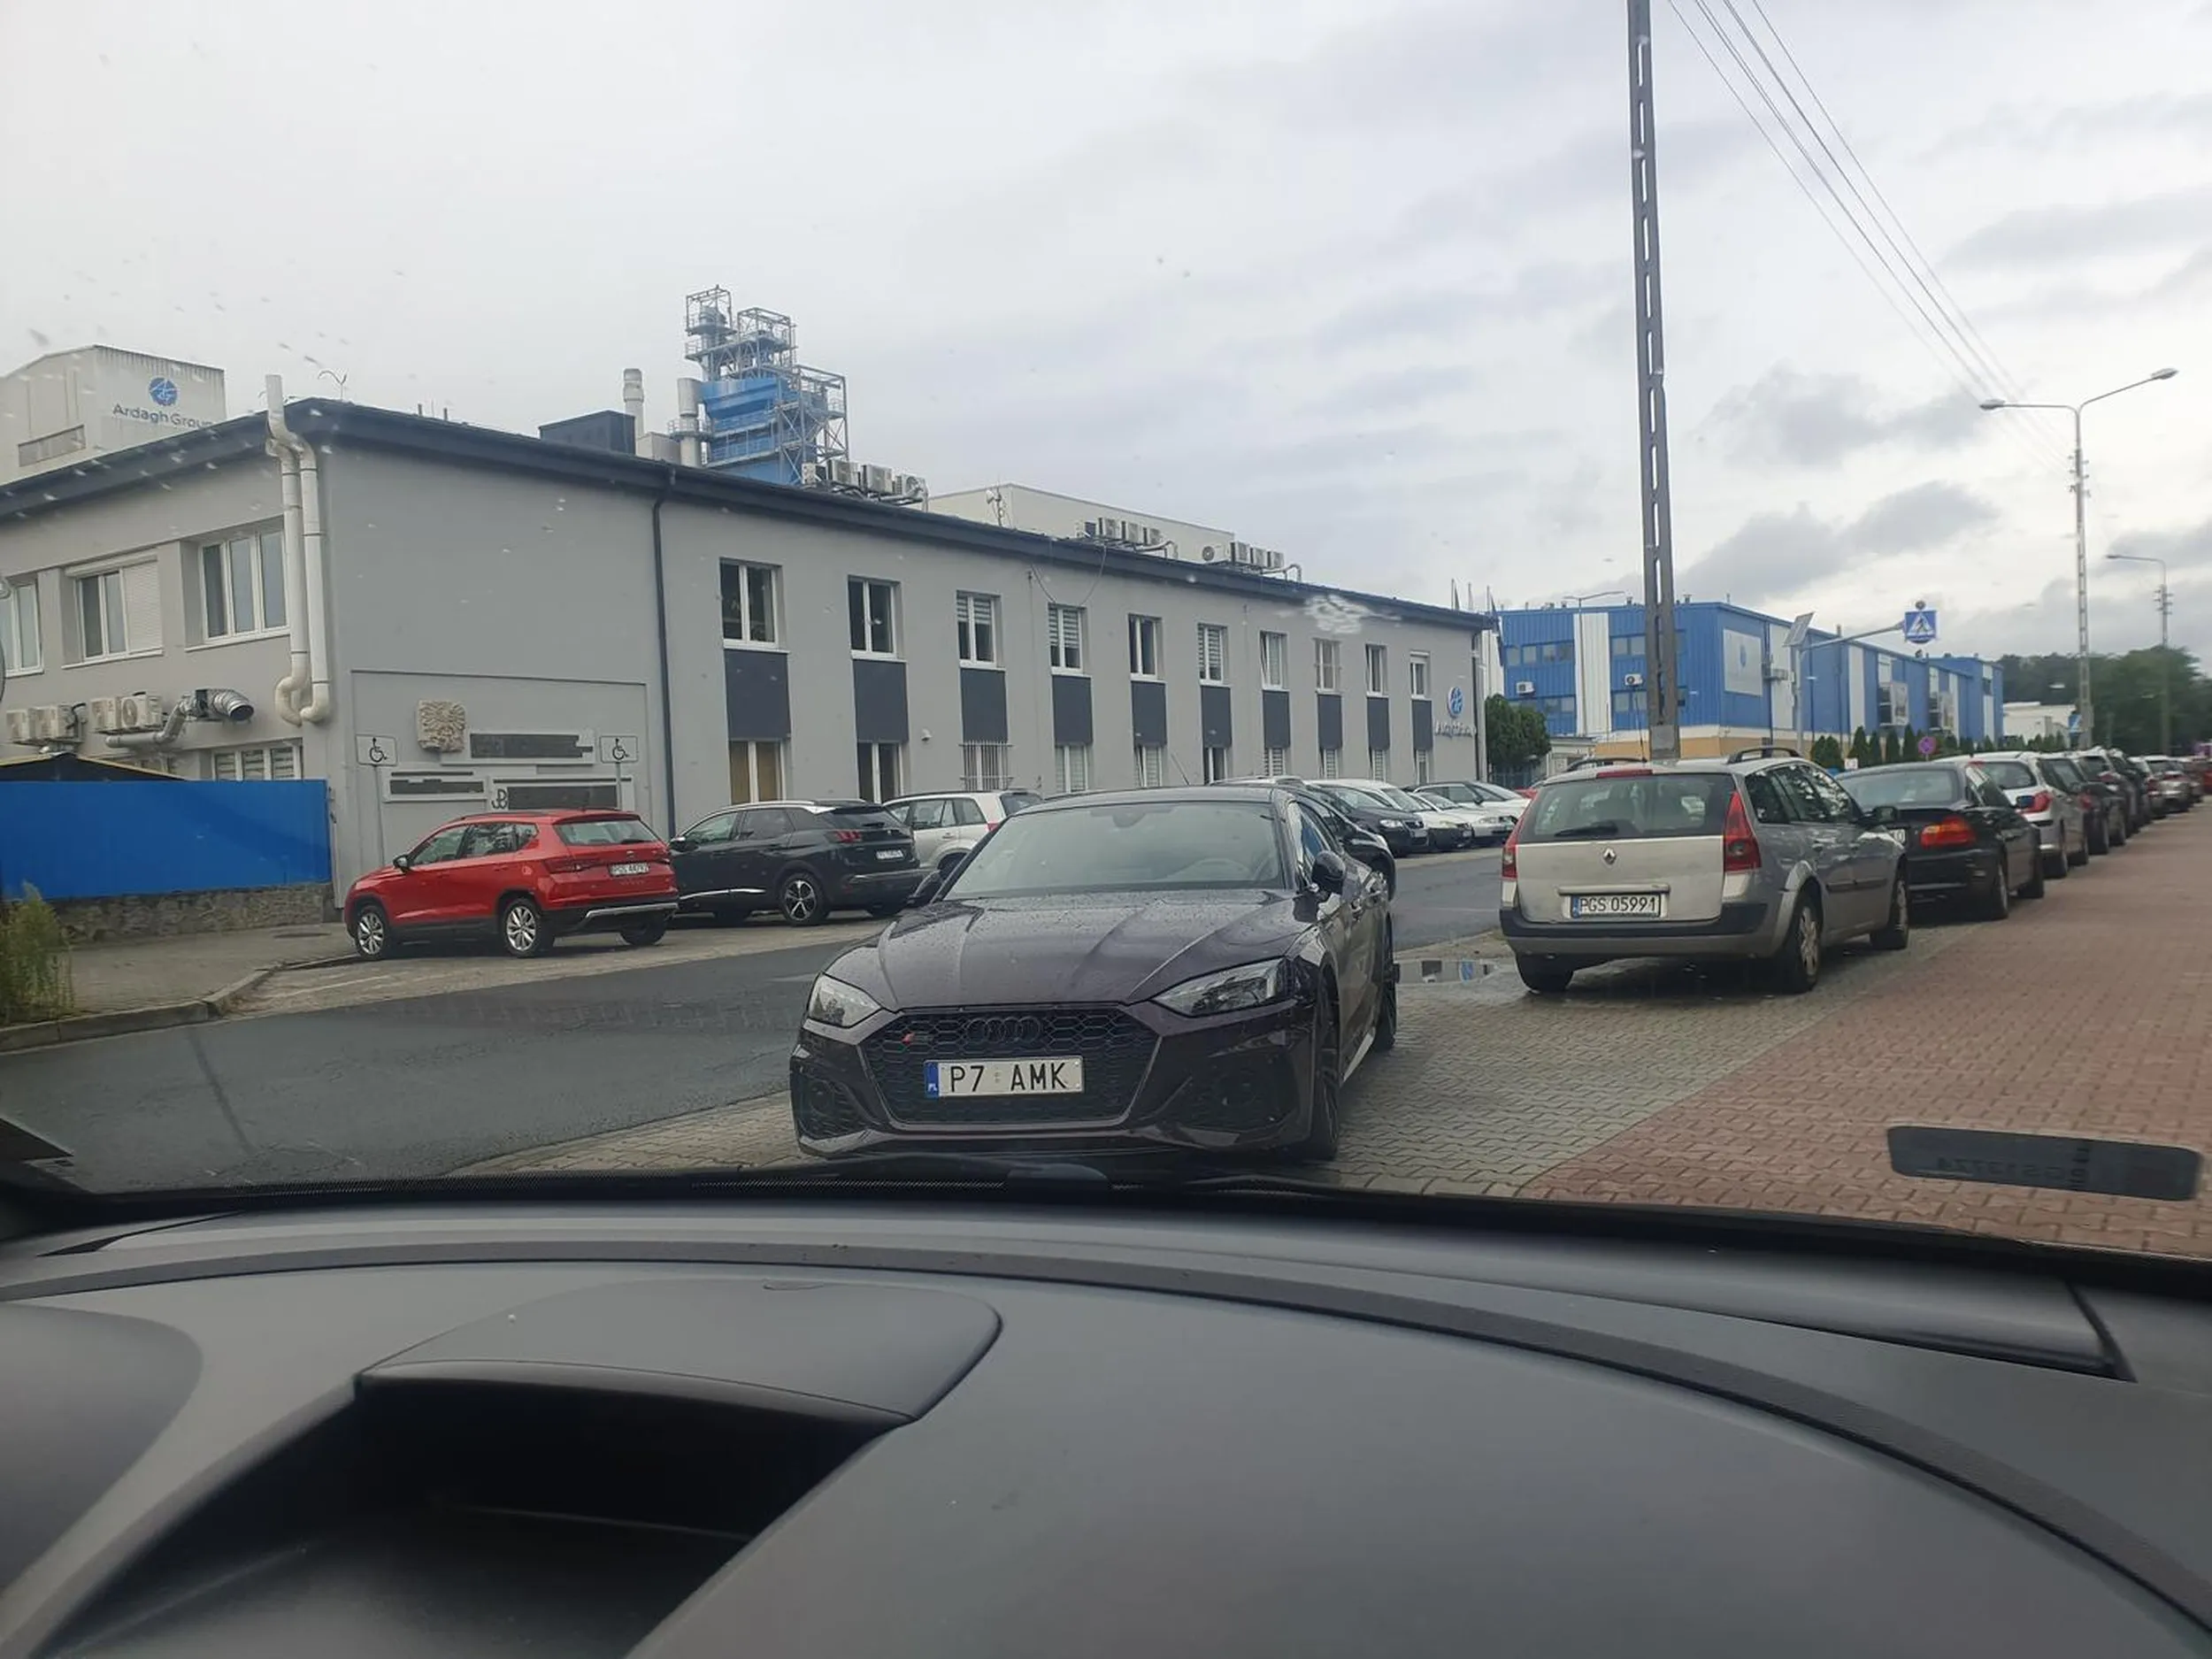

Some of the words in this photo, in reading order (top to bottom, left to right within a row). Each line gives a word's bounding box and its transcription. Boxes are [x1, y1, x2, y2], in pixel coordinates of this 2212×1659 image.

[113, 403, 168, 423] Ardagh
[1579, 897, 1606, 911] PGS
[1610, 896, 1655, 911] 05991
[949, 1064, 985, 1093] P7
[1010, 1062, 1067, 1091] AMK
